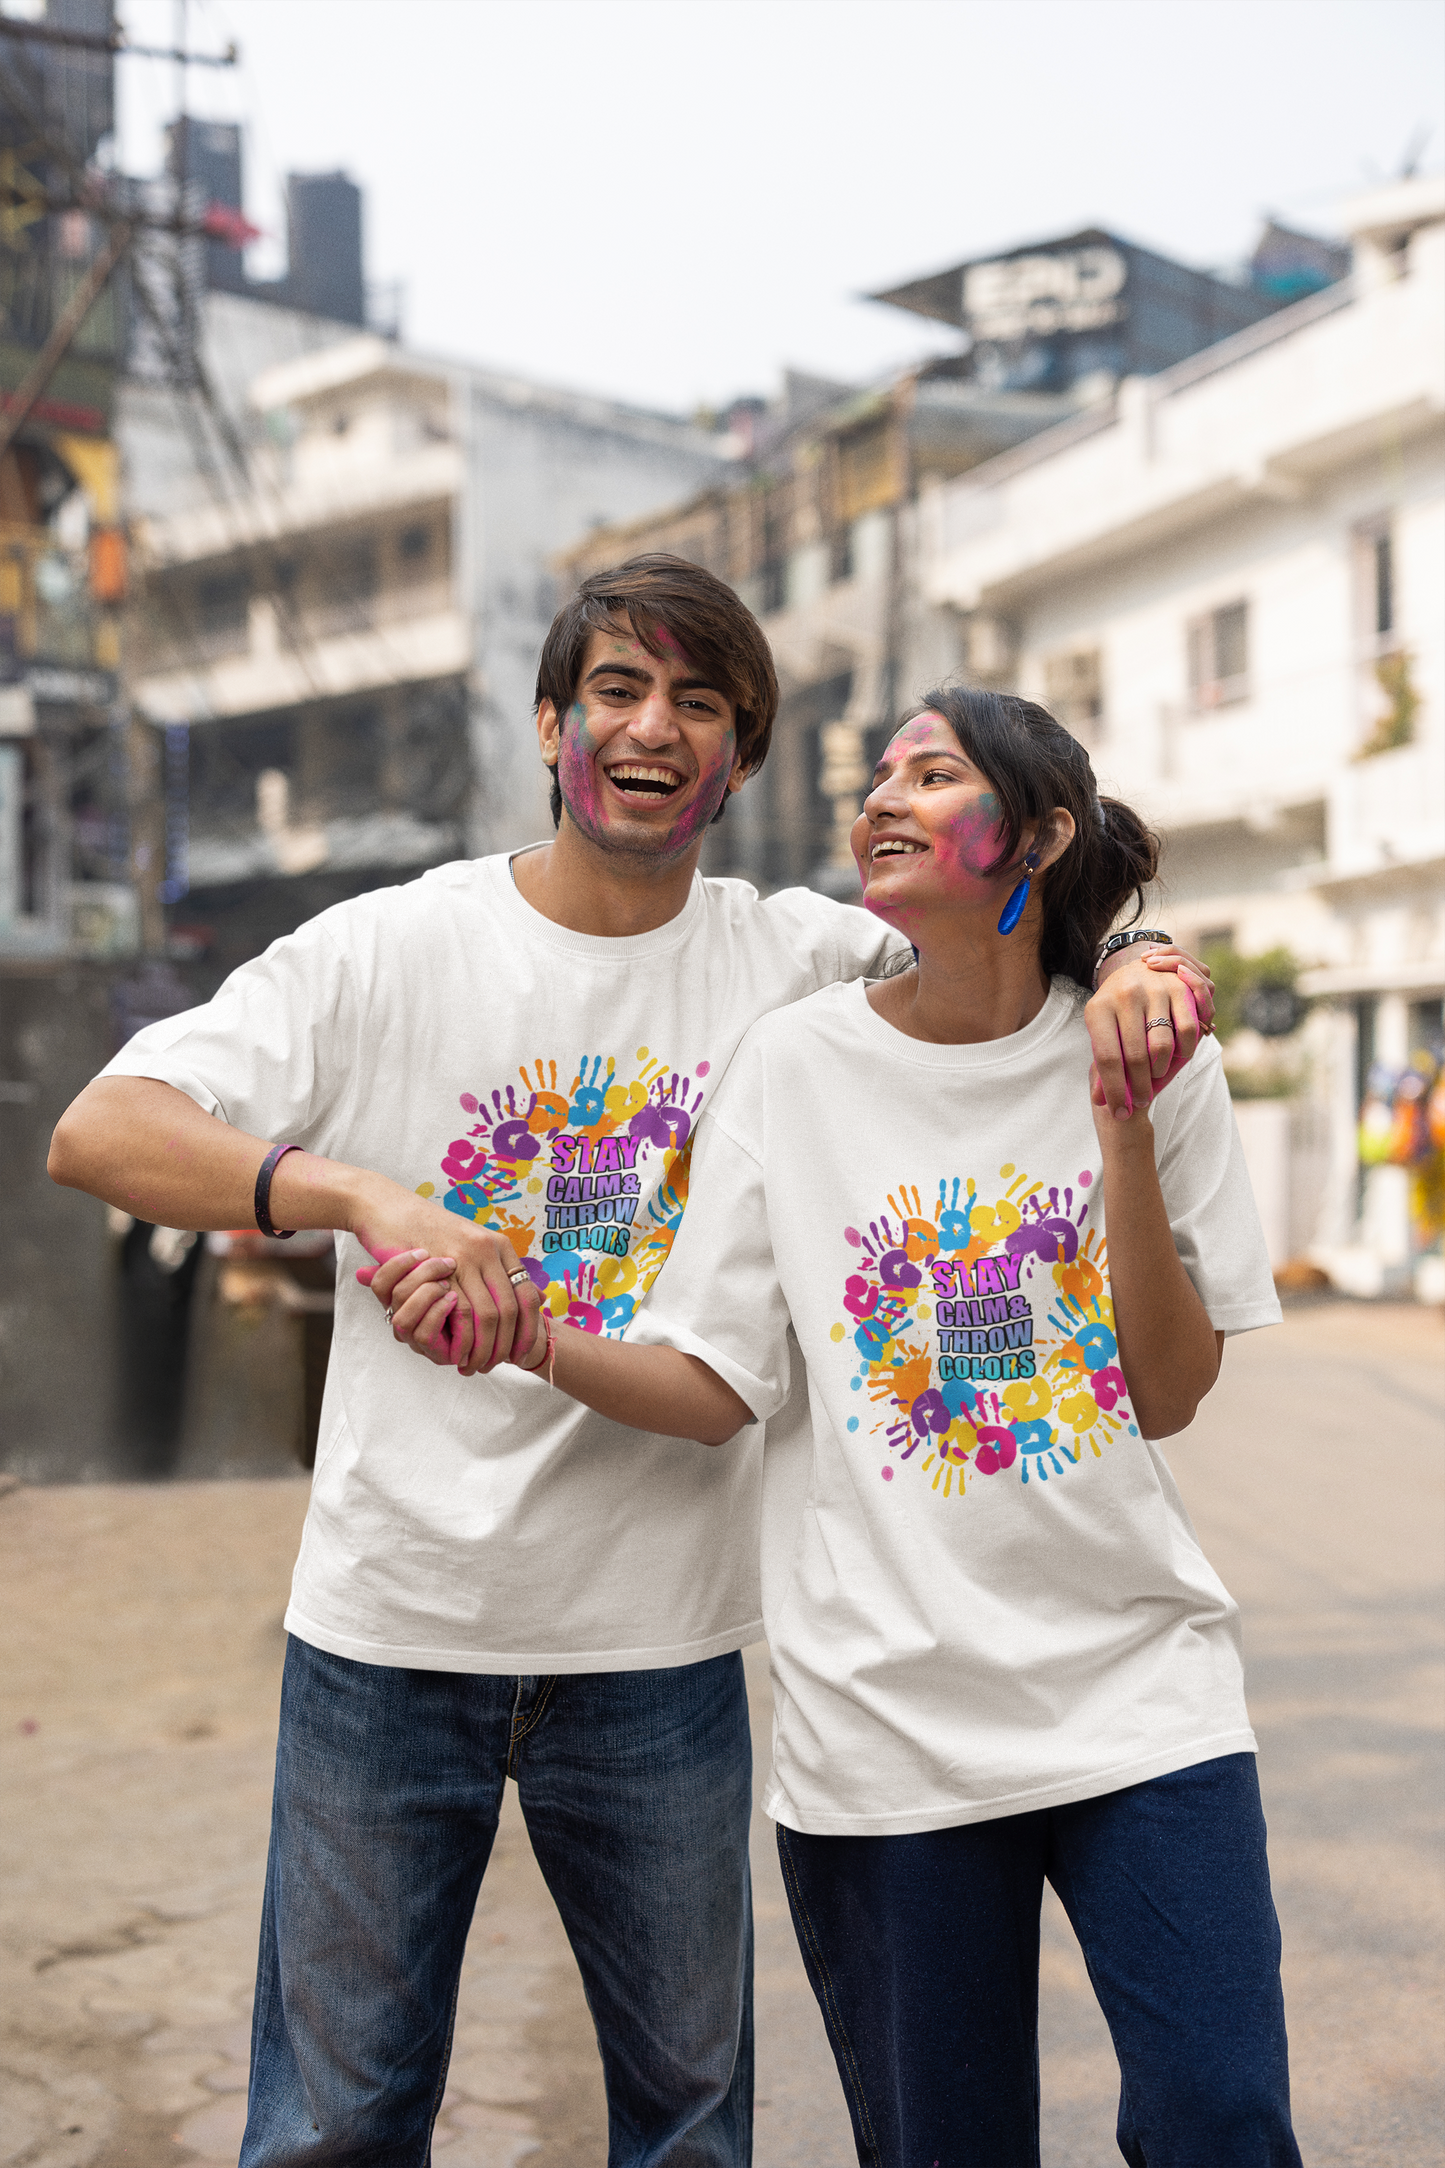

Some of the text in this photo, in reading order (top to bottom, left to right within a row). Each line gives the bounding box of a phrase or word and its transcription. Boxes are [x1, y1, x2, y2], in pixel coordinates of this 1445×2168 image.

[551, 1135, 639, 1174] STAY
[547, 1173, 641, 1204] CALM&
[545, 1197, 639, 1229] THROW
[542, 1225, 630, 1257] COLORS
[931, 1253, 1022, 1299] STAY
[936, 1295, 1032, 1328] CALM&
[937, 1318, 1033, 1354] THROW
[938, 1349, 1036, 1381] COLORS
